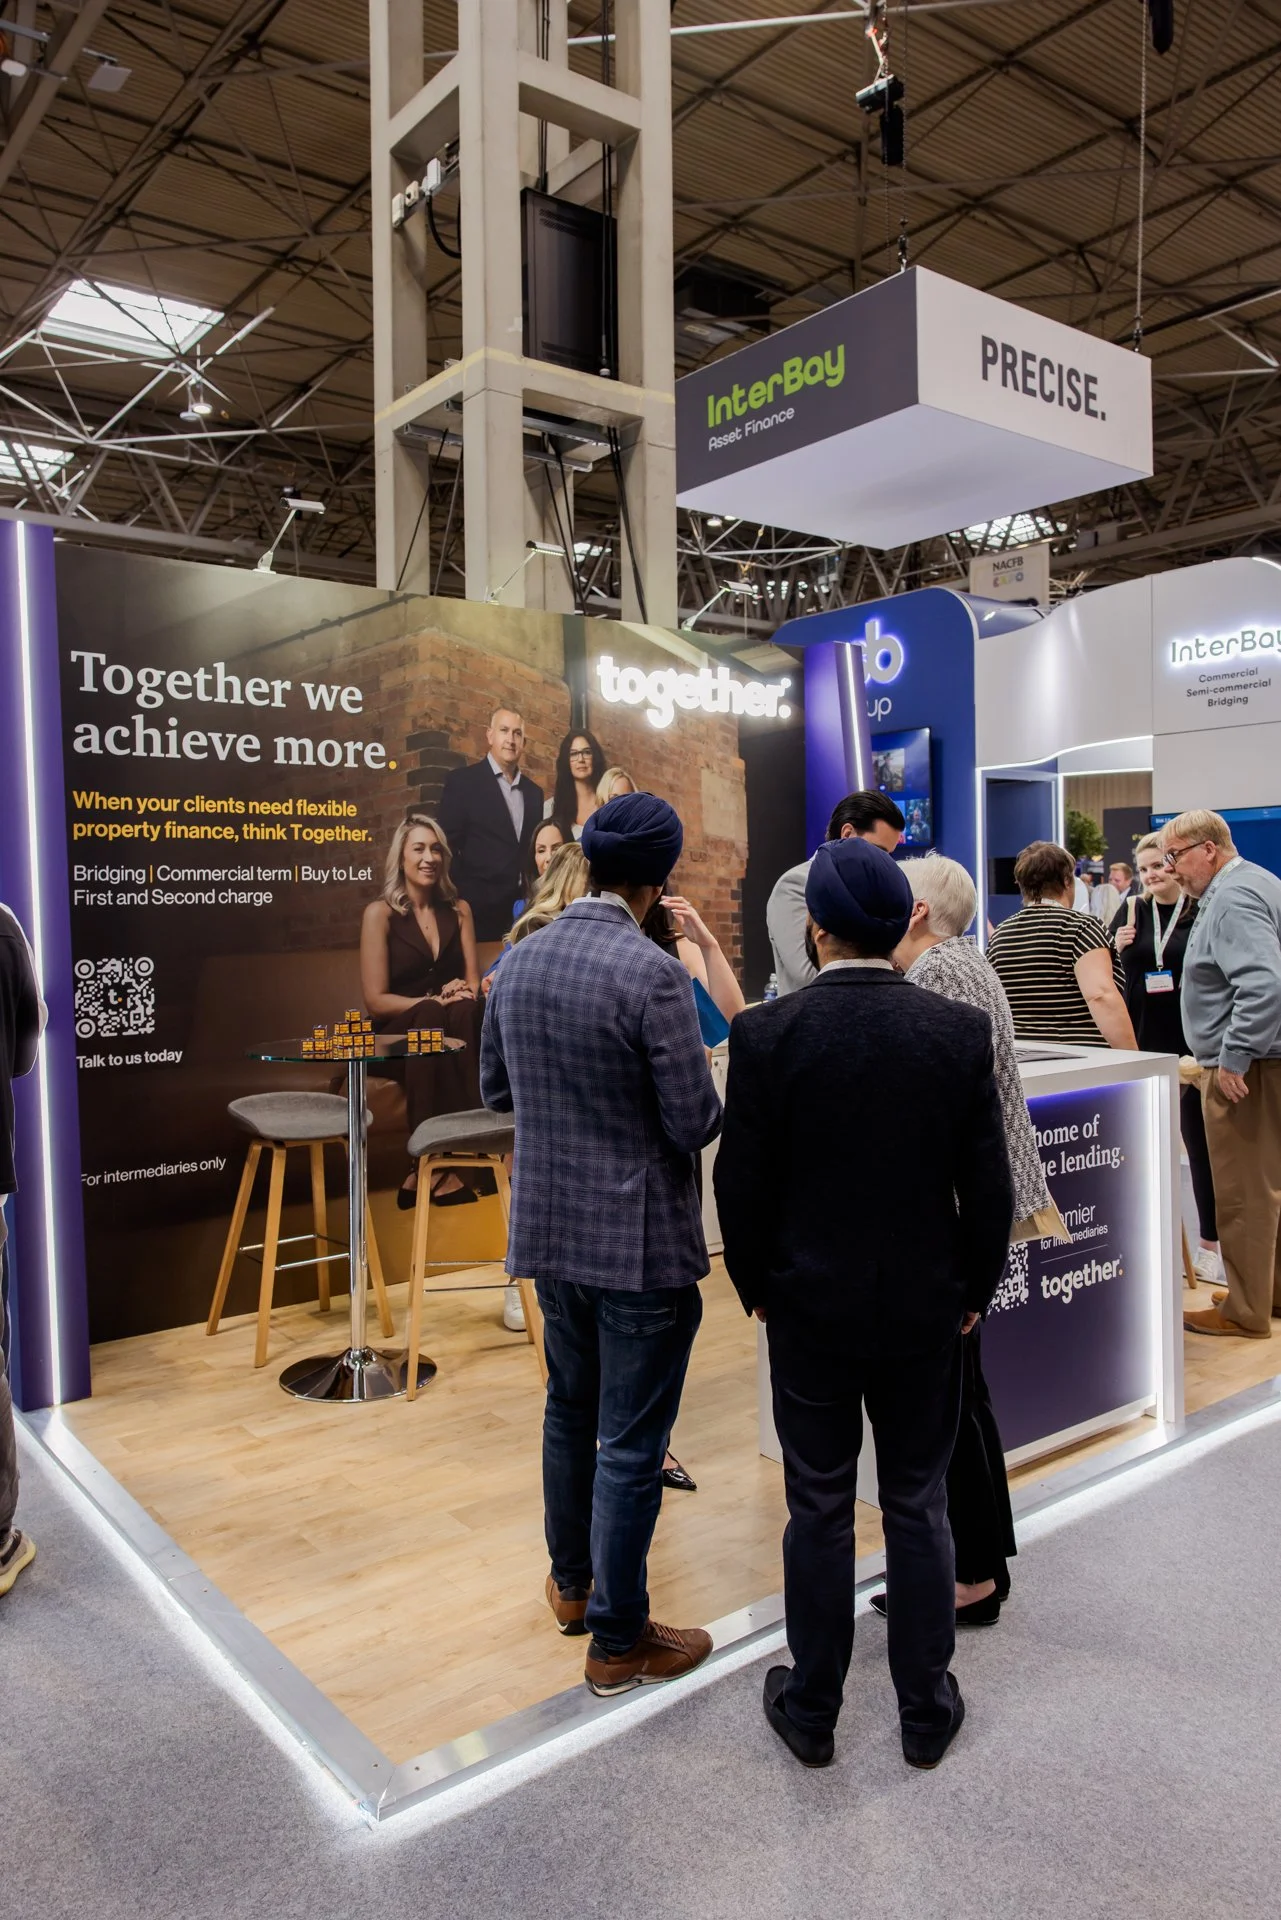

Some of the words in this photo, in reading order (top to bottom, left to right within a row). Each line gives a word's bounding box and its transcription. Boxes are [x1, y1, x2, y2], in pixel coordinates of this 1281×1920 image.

[707, 343, 846, 428] InterBay
[981, 334, 1107, 422] PRECISE.
[708, 427, 743, 451] Asset
[744, 407, 796, 437] Finance
[992, 555, 1024, 572] NACFB
[70, 650, 292, 709] Together
[301, 682, 363, 714] we
[1186, 678, 1272, 697] Semi-commercial
[1198, 667, 1259, 683] Commercial
[1207, 695, 1249, 708] Bridging
[72, 713, 262, 763] achieve
[273, 735, 397, 770] more.
[72, 790, 133, 811] When
[136, 796, 181, 815] your
[183, 795, 245, 814] clients
[248, 798, 293, 816] need
[296, 799, 358, 817] flexible
[73, 821, 161, 842] property
[164, 820, 240, 843] finance,
[242, 823, 288, 841] think
[290, 823, 373, 844] Together.
[73, 864, 146, 885] Bridging
[156, 865, 254, 882] Commercial
[256, 867, 292, 881] term
[301, 866, 330, 884] Buy
[332, 866, 347, 881] to
[349, 866, 373, 881] Let
[73, 889, 113, 906] First
[116, 889, 149, 906] and
[151, 888, 216, 906] Second
[218, 888, 273, 907] charge
[76, 1054, 106, 1069] Talk
[108, 1053, 123, 1066] to
[125, 1053, 142, 1065] us
[144, 1048, 183, 1063] today
[1082, 1113, 1100, 1139] of
[103, 1161, 199, 1184] intermediaries
[199, 1156, 227, 1171] only
[1060, 1144, 1125, 1174] lending.
[1040, 1237, 1052, 1251] for
